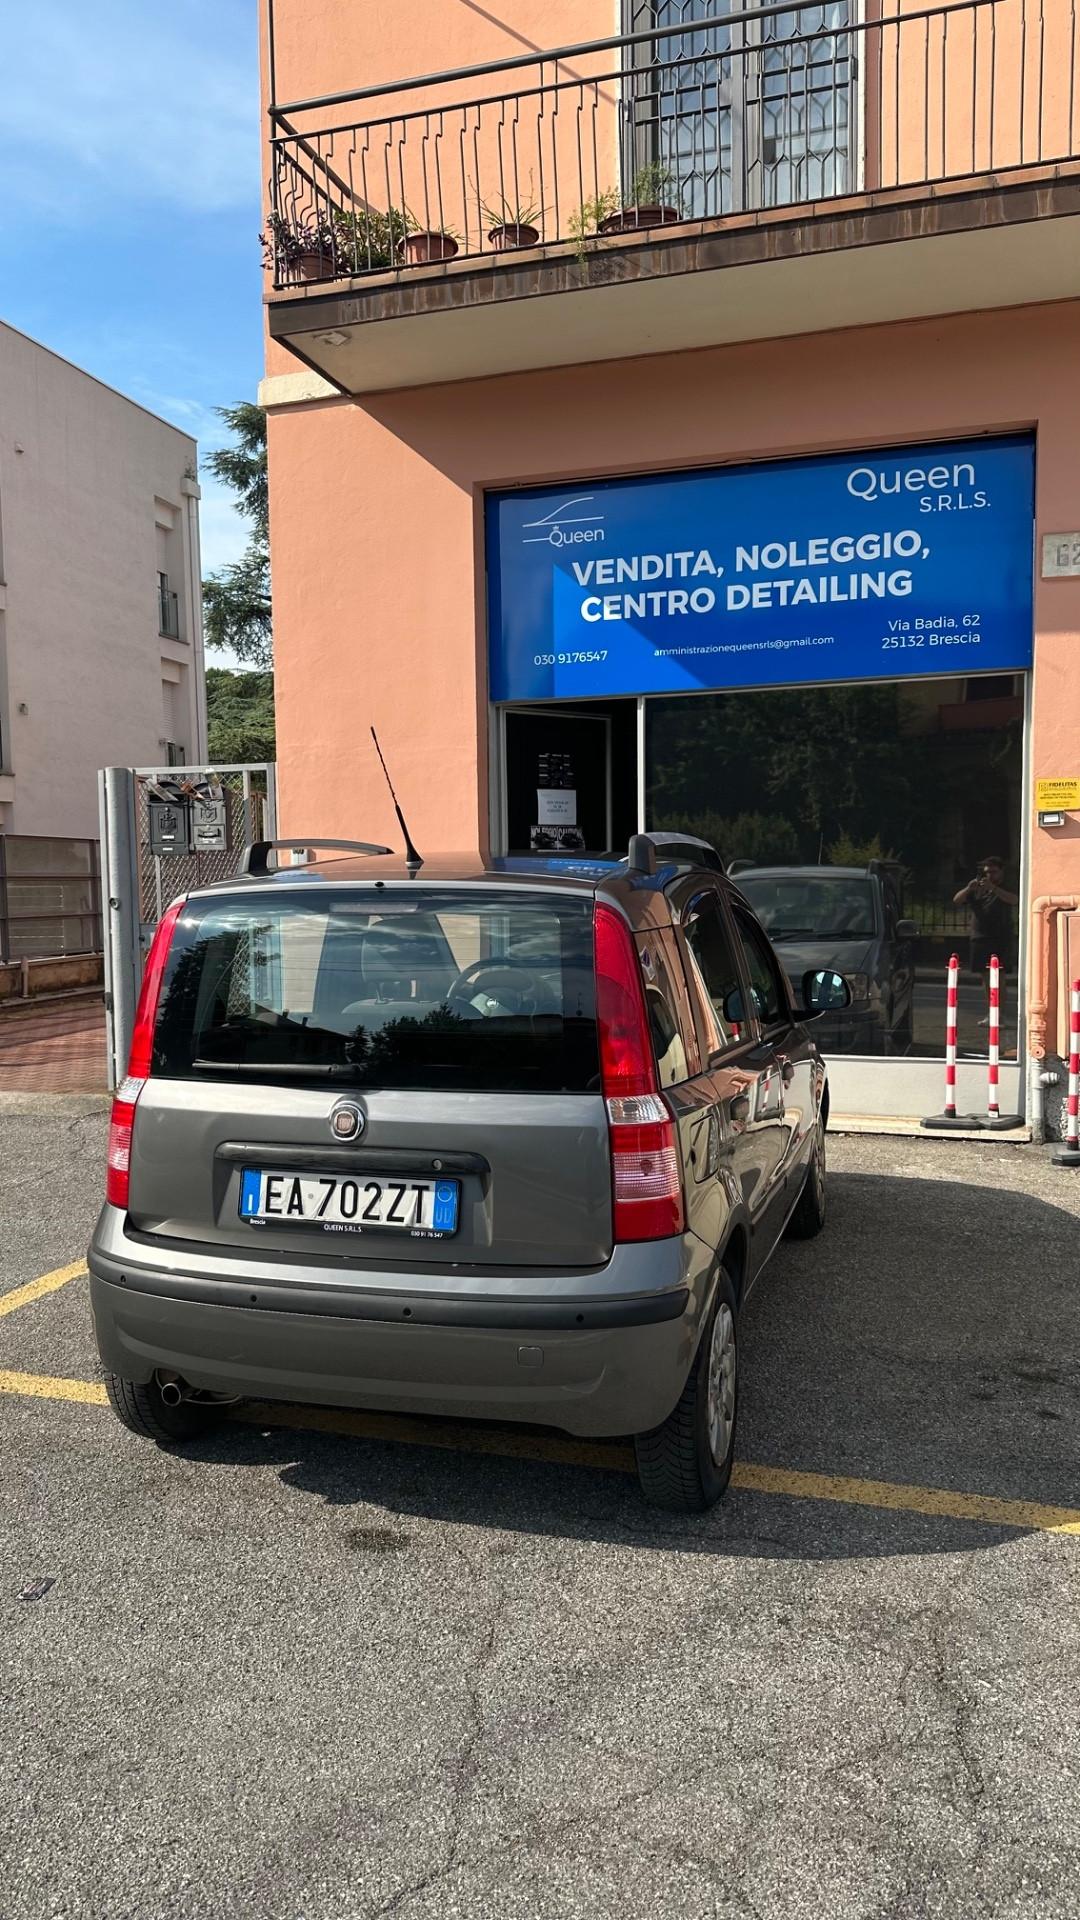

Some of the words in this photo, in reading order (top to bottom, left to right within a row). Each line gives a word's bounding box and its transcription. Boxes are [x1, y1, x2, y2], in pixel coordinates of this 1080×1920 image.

[847, 463, 976, 501] Queen
[919, 491, 991, 513] S.R.L.S.
[549, 528, 605, 548] Queen
[572, 549, 724, 586] VENDITA,
[735, 529, 930, 572] NOLEGGIO,
[580, 586, 716, 623] CENTRO
[726, 569, 913, 611] DETAILING
[888, 619, 910, 632] Via
[915, 616, 959, 630] Badia,
[962, 614, 981, 627] 62
[653, 635, 835, 657] amministrazionequeensrls@gmail.com
[881, 634, 925, 649] 25132
[929, 631, 981, 646] Brescia
[534, 654, 556, 666] 030
[557, 650, 608, 664] 9176547
[323, 1223, 344, 1232] QUEEN
